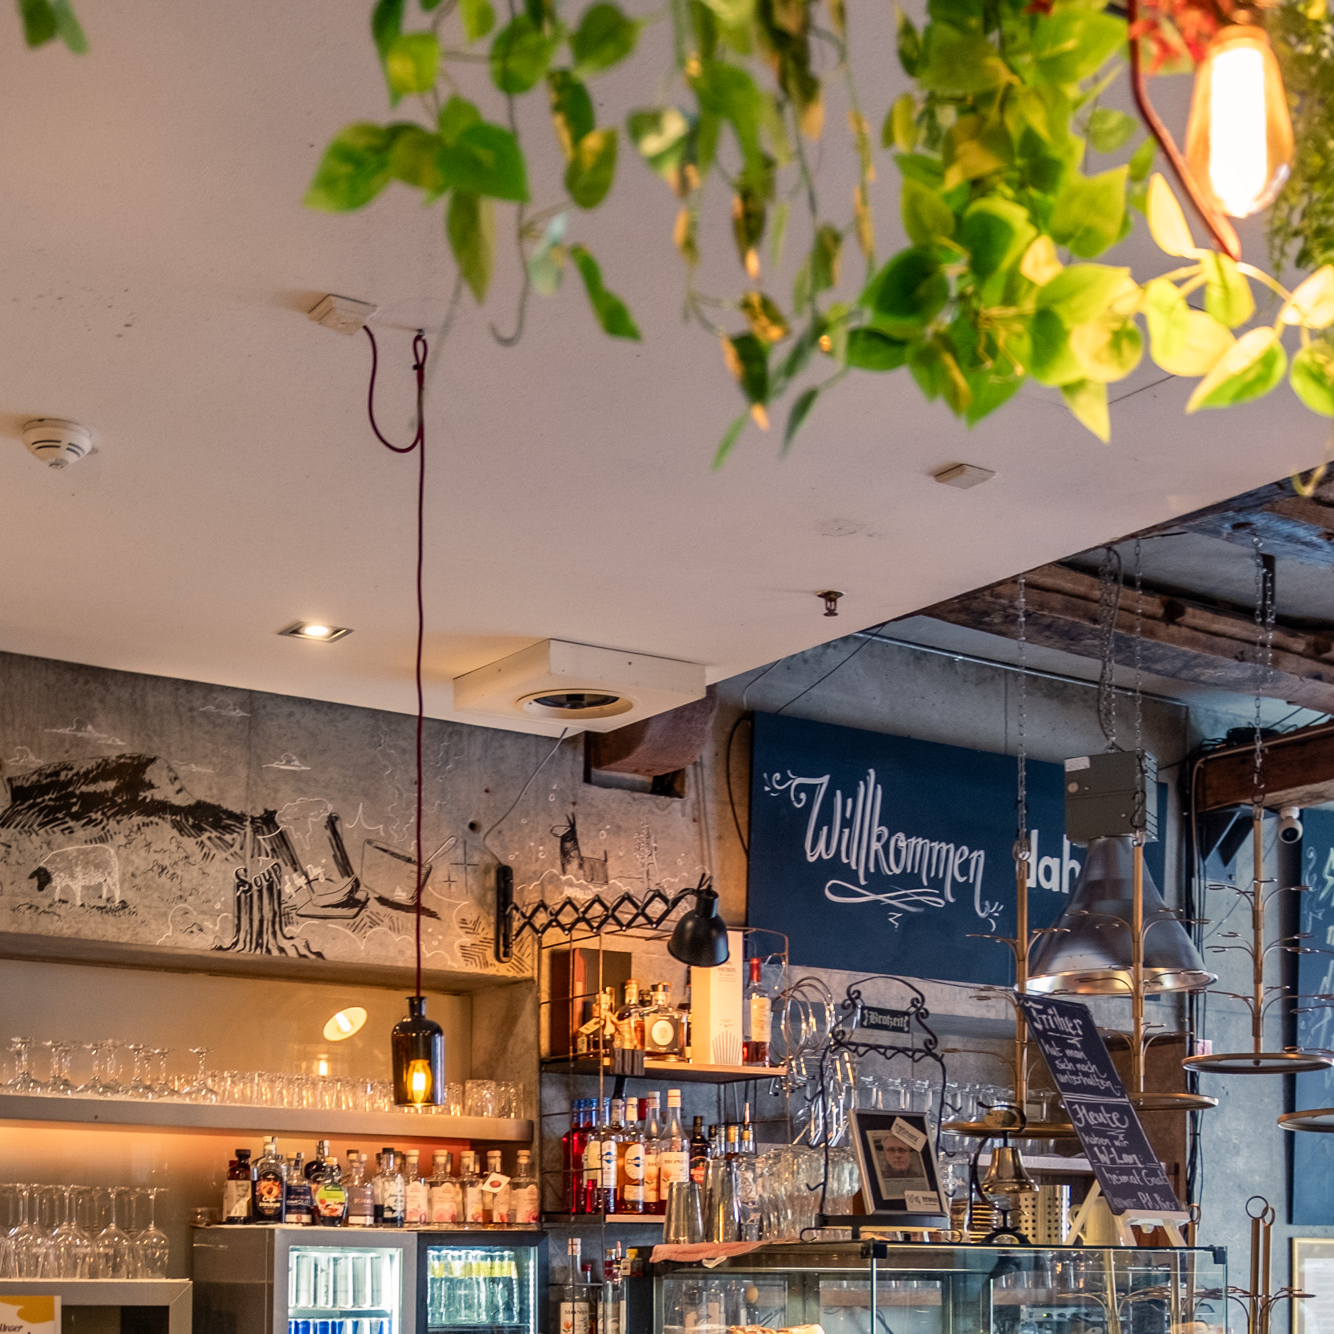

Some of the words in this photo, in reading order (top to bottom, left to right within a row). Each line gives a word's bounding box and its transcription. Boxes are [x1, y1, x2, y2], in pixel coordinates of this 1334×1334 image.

[789, 768, 991, 918] Willkommen
[233, 861, 282, 897] Soup
[1072, 1103, 1129, 1128] Heute
[0, 1323, 24, 1333] Unser
